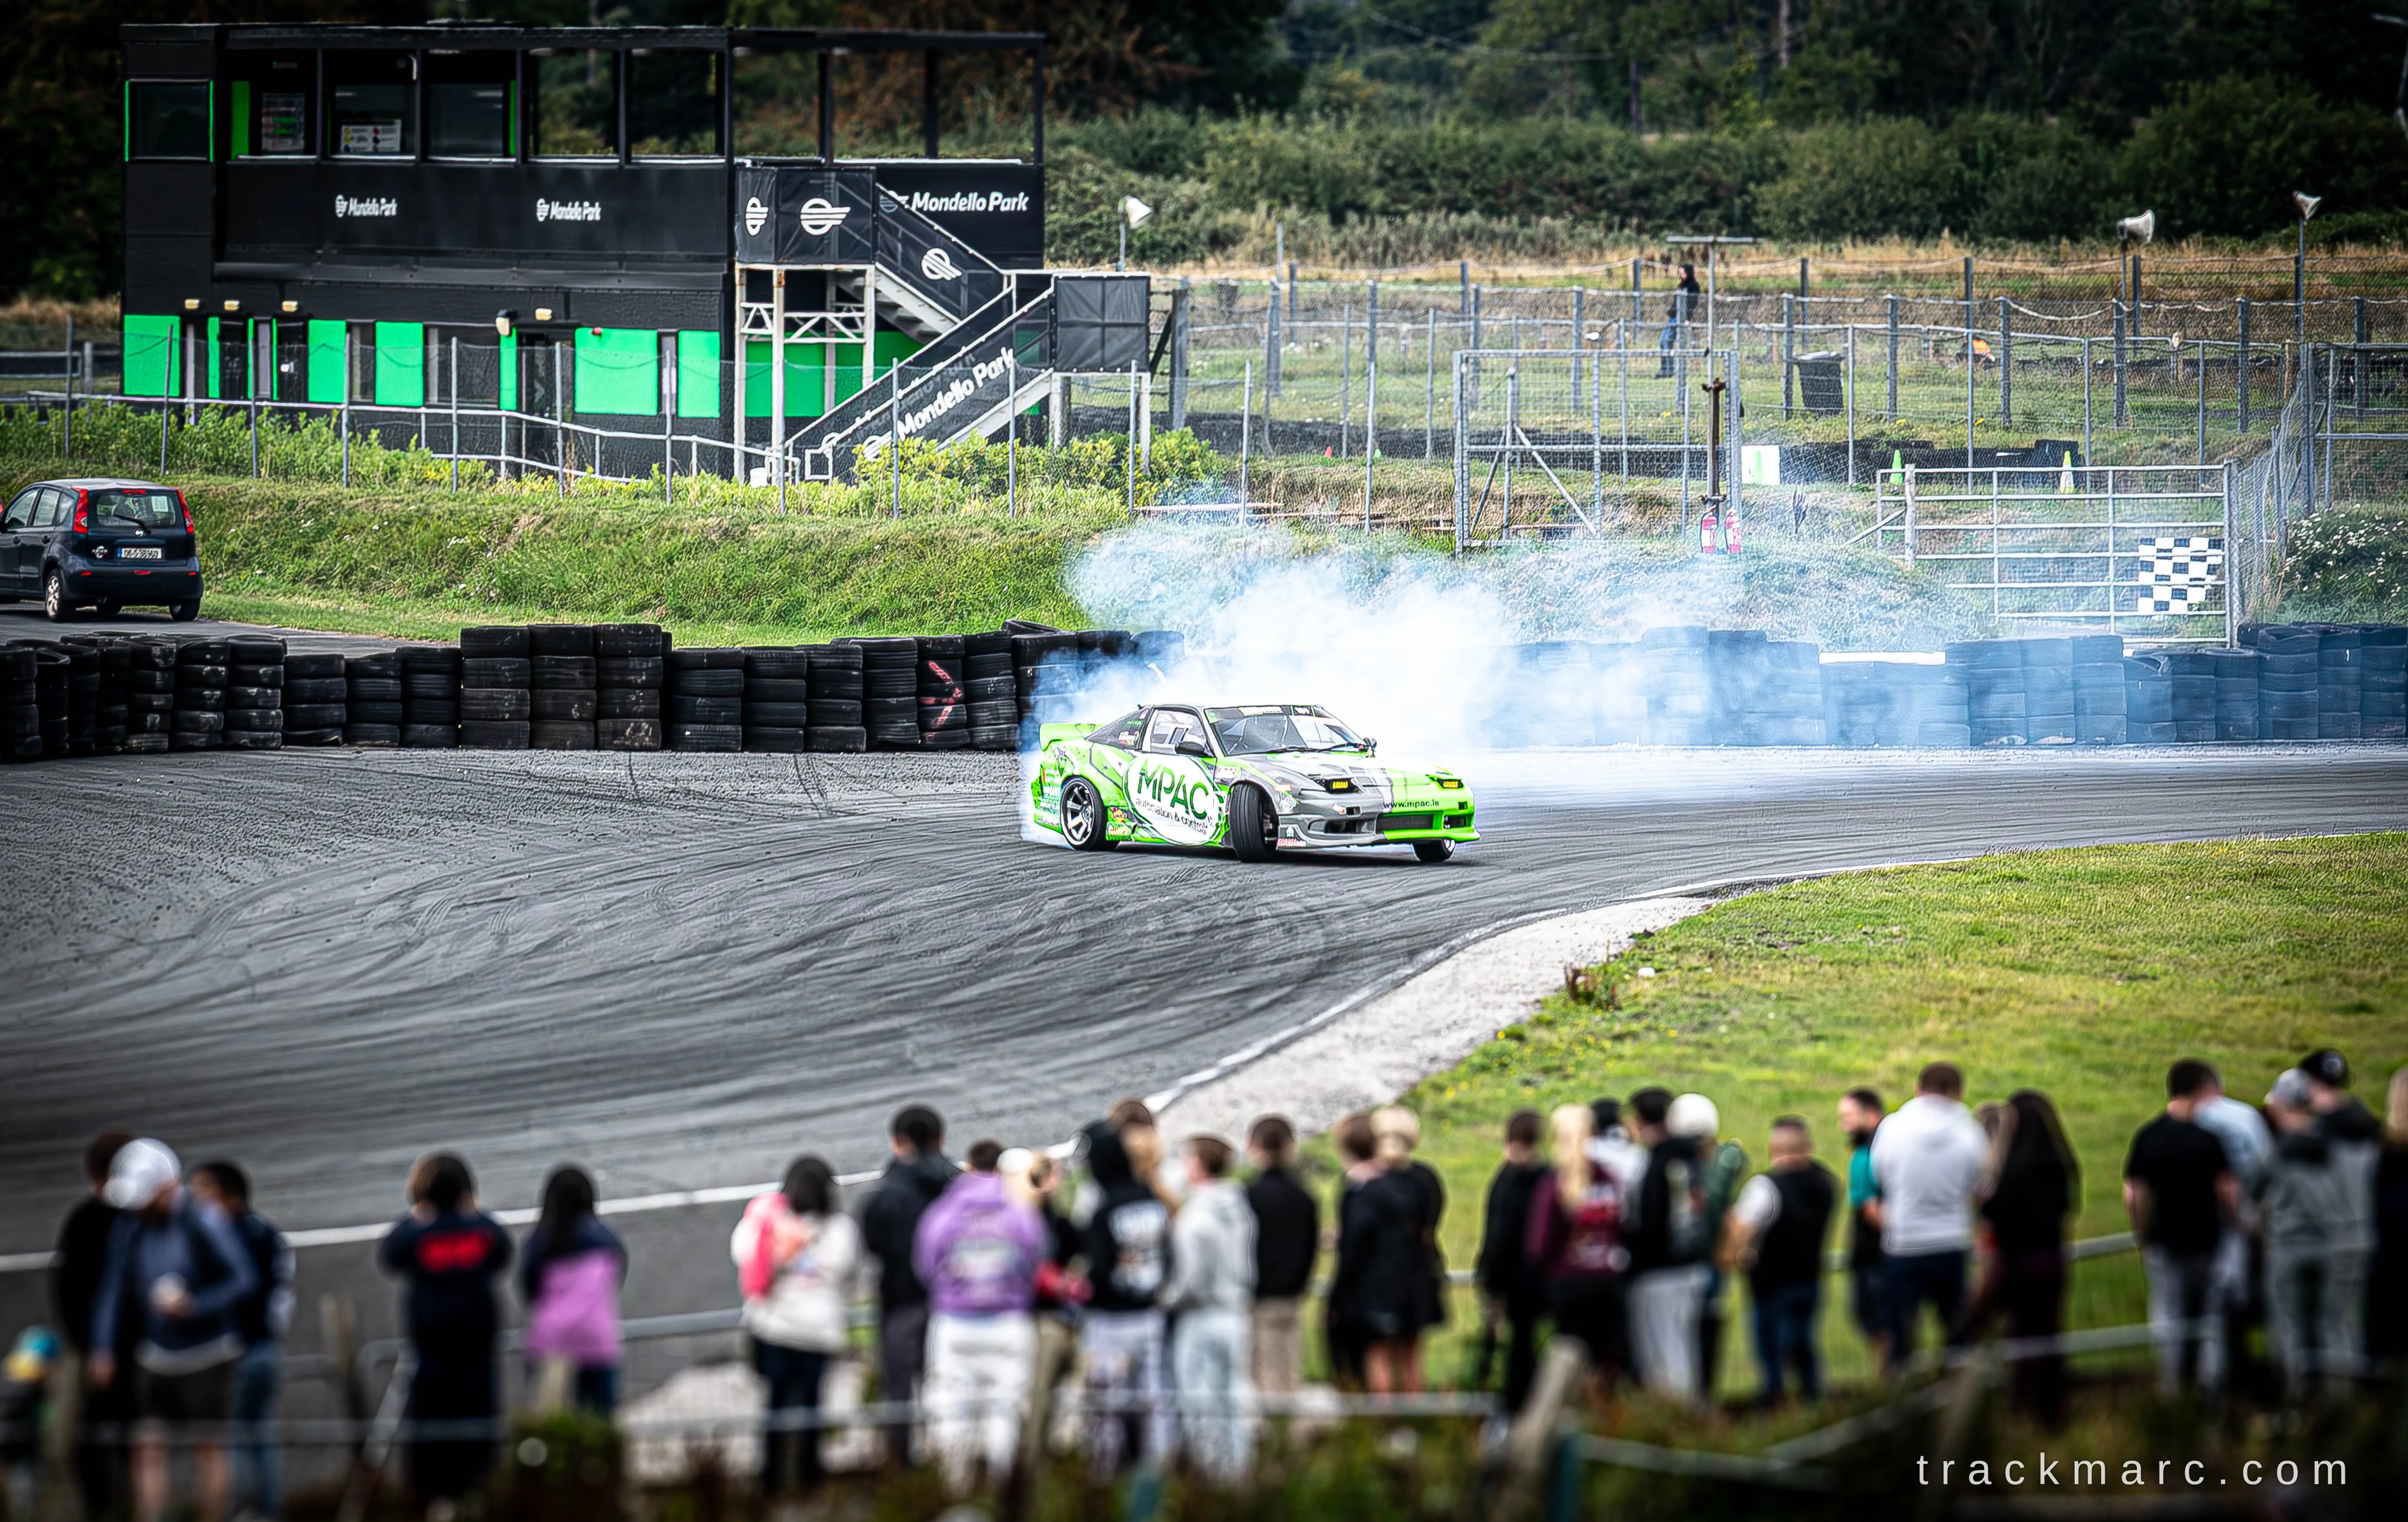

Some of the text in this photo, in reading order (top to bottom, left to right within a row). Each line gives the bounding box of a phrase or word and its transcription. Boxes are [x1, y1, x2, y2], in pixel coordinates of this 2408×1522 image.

[380, 198, 398, 216] Park
[582, 201, 601, 221] Park
[912, 192, 1029, 212] Mondello Park
[897, 378, 975, 441] Mondello
[972, 347, 1014, 387] Park
[1137, 758, 1209, 820] MPAC
[1136, 798, 1173, 820] automation
[1174, 812, 1180, 822] &
